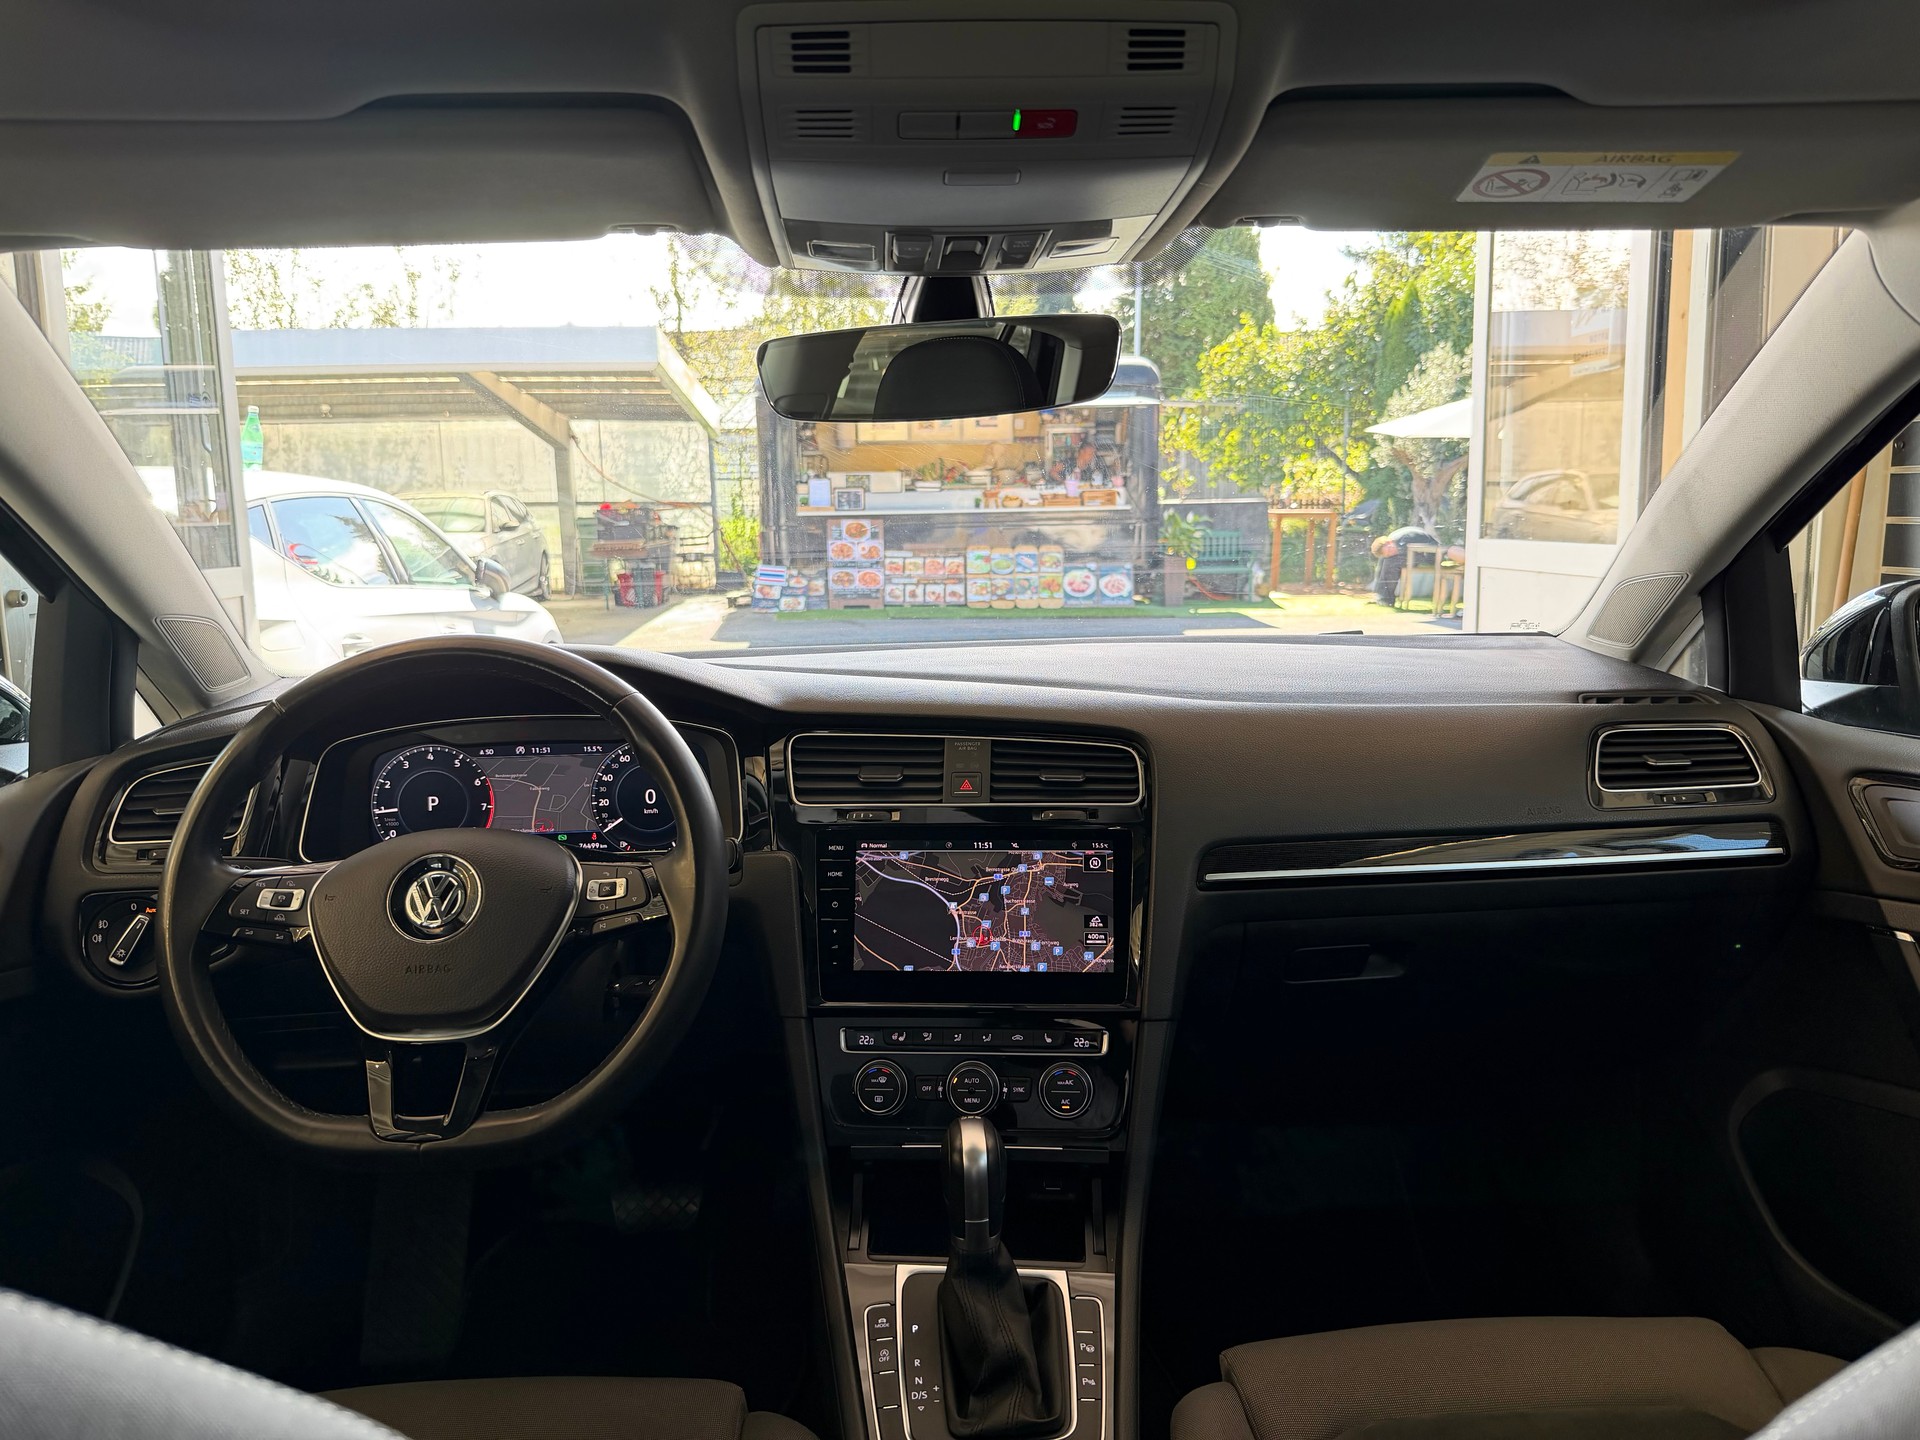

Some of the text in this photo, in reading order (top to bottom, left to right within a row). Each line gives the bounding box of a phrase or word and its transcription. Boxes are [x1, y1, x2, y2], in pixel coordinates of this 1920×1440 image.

[1593, 154, 1676, 163] AIRBAG
[426, 753, 435, 761] 4
[402, 761, 410, 769] 3
[454, 760, 461, 768] 5
[602, 774, 613, 782] 40
[384, 780, 391, 789] 2
[645, 788, 656, 804] 0
[427, 796, 439, 811] P
[389, 830, 397, 838] 0
[973, 841, 993, 849] 11:51
[405, 871, 466, 928] VW
[405, 965, 452, 974] AIRBAG
[911, 1324, 919, 1333] P
[914, 1358, 921, 1367] R
[915, 1377, 923, 1385] N
[911, 1391, 928, 1400] D/S
